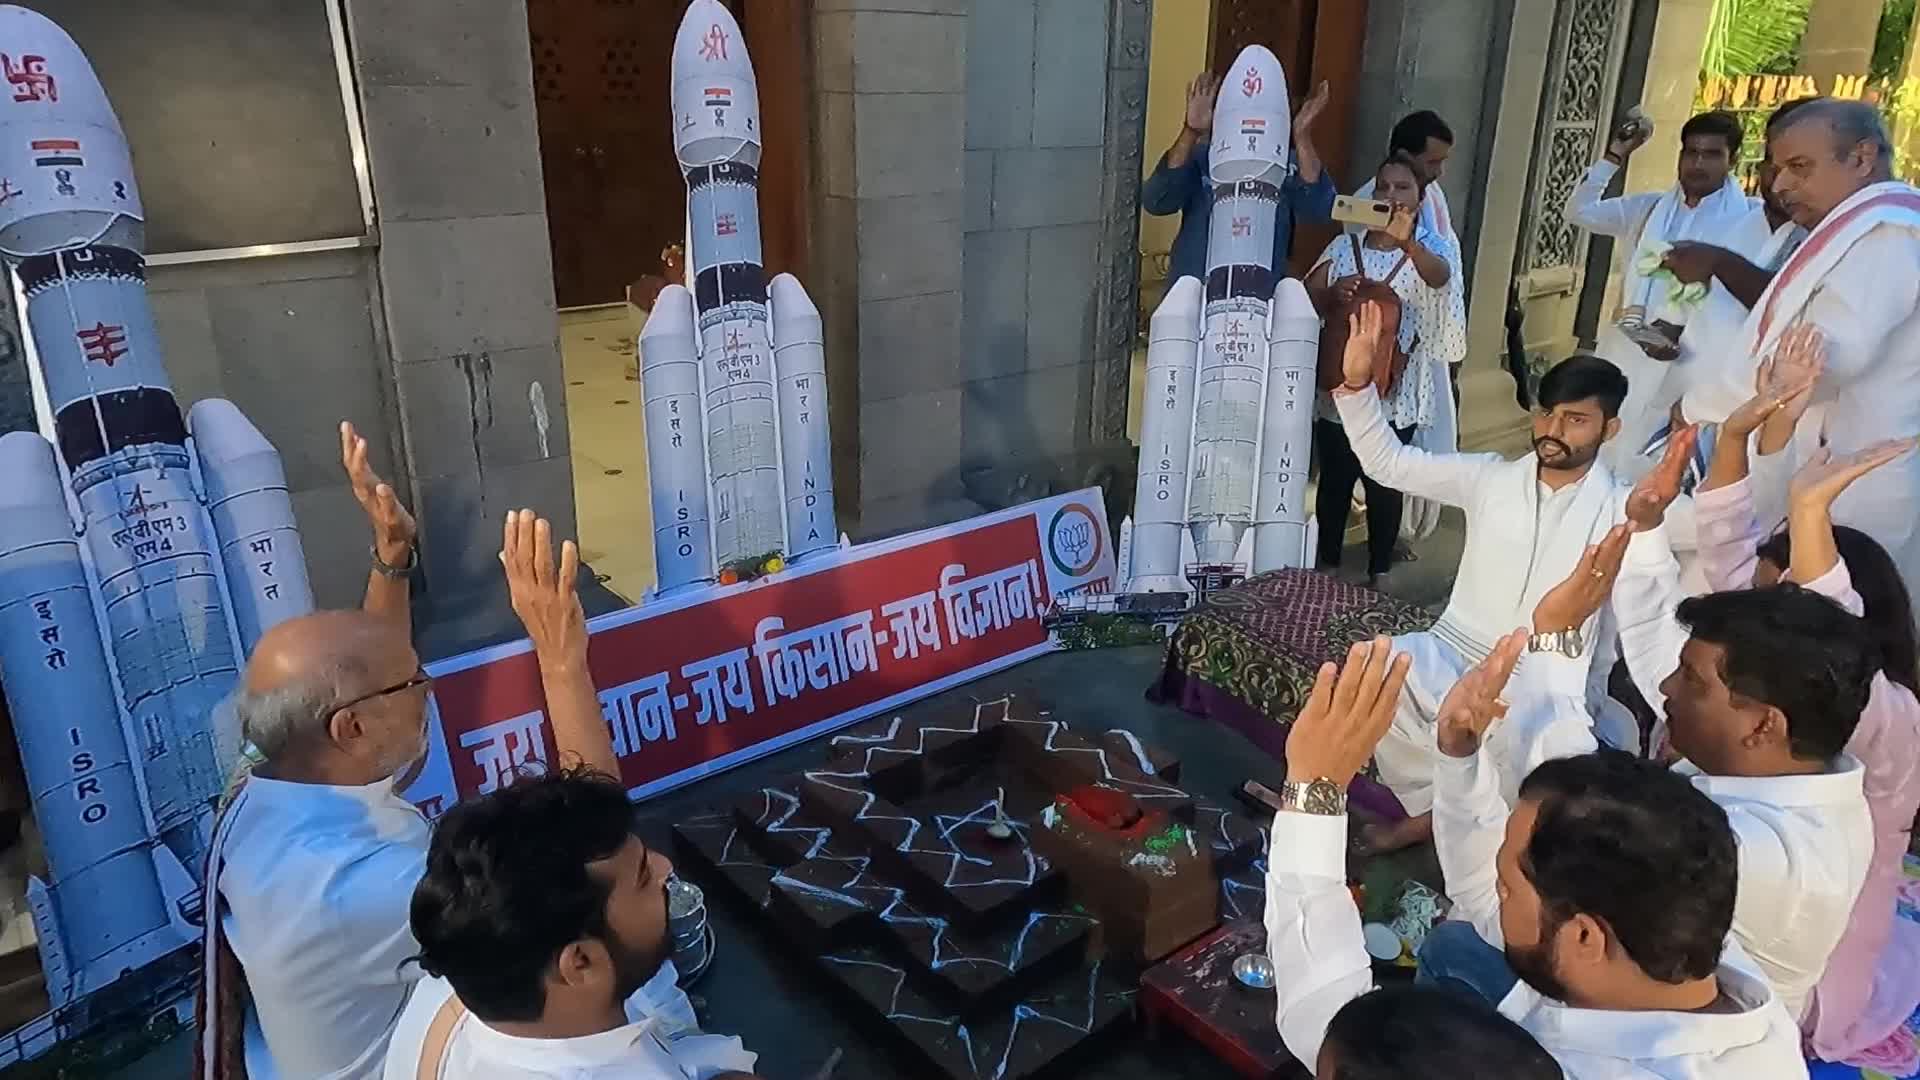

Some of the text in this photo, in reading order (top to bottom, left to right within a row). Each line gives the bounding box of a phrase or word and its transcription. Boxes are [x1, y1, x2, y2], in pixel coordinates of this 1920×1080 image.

[804, 460, 820, 540] INDIA
[1157, 444, 1170, 501] ISRO
[1275, 442, 1291, 513] INDIA
[677, 489, 692, 556] ISRO
[250, 537, 279, 600] भारत
[34, 600, 67, 669] इसरो
[70, 728, 107, 823] ISRO
